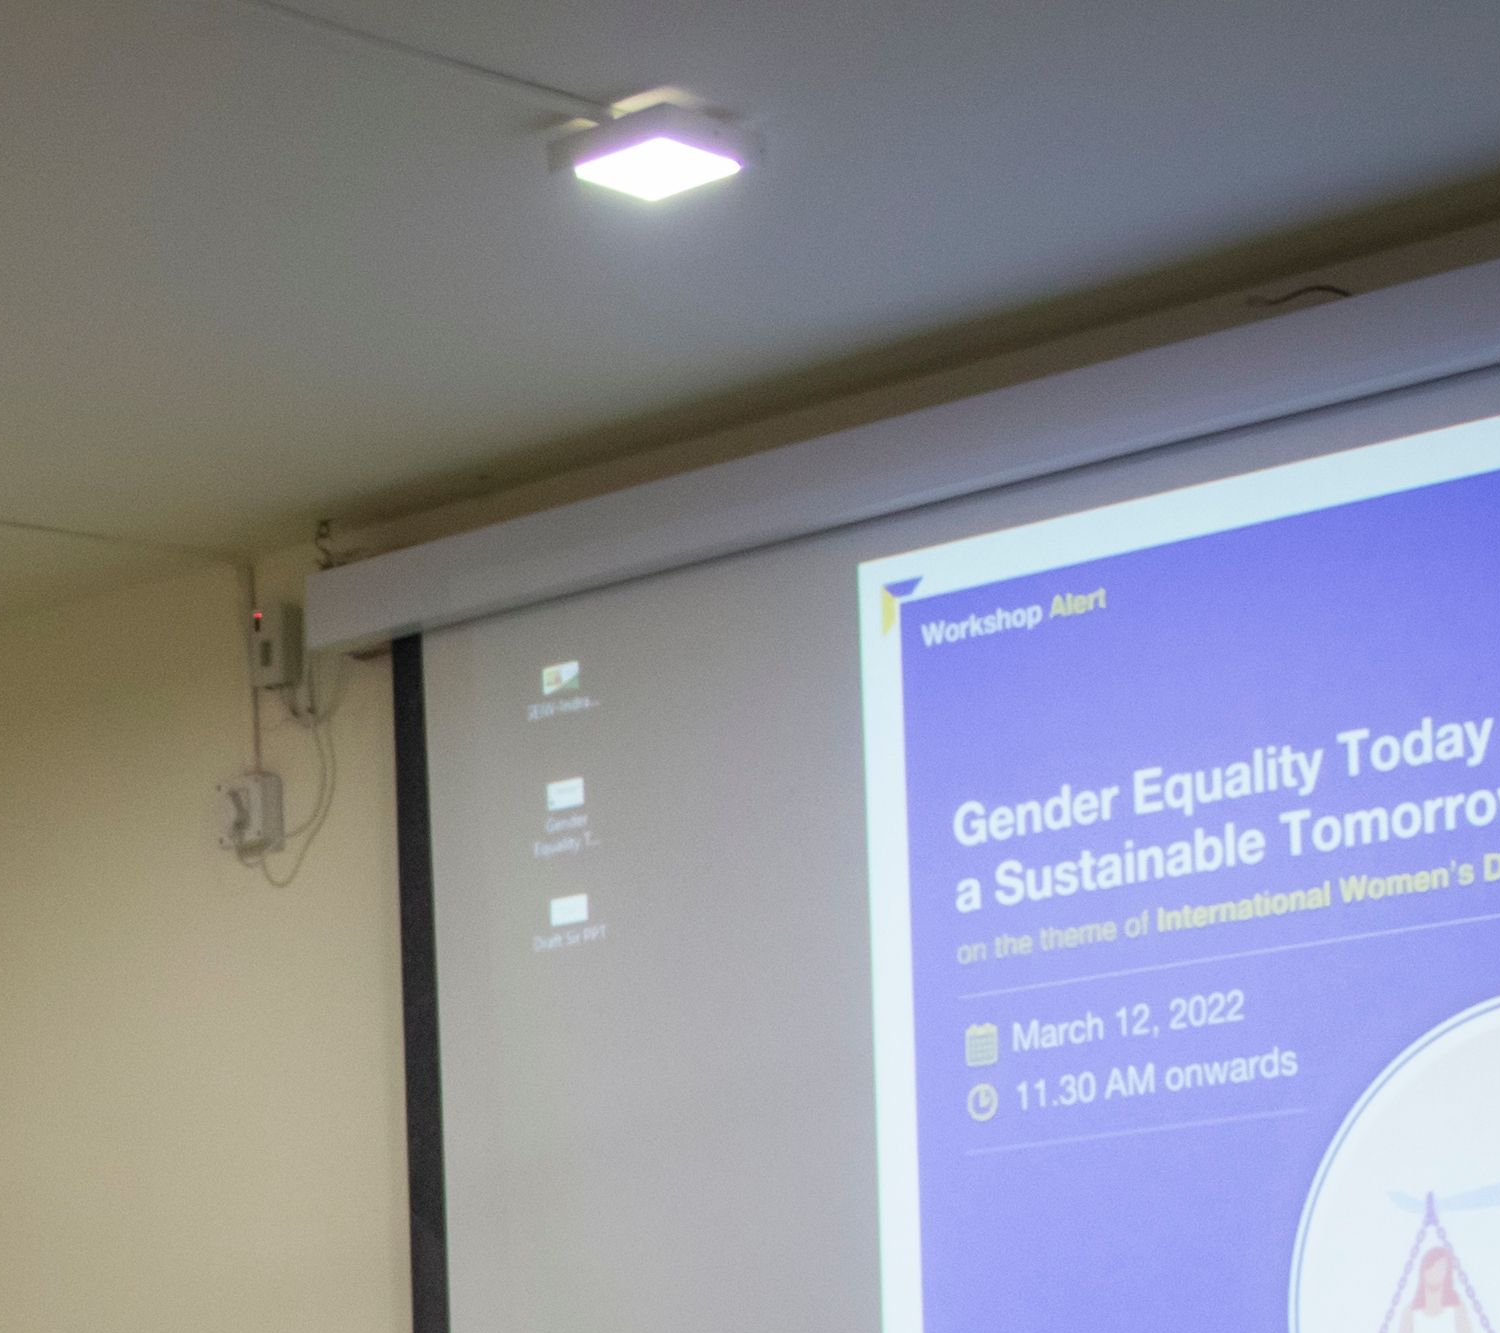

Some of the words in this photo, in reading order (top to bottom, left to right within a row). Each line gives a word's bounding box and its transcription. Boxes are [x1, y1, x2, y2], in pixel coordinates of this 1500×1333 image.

[921, 603, 1042, 647] Workshop
[1050, 587, 1106, 619] Alert
[952, 781, 1119, 846] Gender
[1132, 744, 1323, 816] Equality
[1337, 716, 1493, 776] Today
[955, 877, 982, 912] a
[994, 823, 1266, 906] Sustainable
[957, 939, 987, 964] on
[995, 930, 1033, 960] the
[1040, 916, 1117, 953] theme
[1125, 911, 1150, 938] of
[1157, 881, 1331, 934] International
[1339, 858, 1475, 905] Women's
[1012, 1011, 1103, 1052] March
[1116, 1000, 1160, 1038] 12,
[1170, 990, 1245, 1031] 2022
[1017, 1071, 1097, 1111] 11.30
[1105, 1062, 1156, 1100] AM
[1165, 1047, 1298, 1092] onwards
